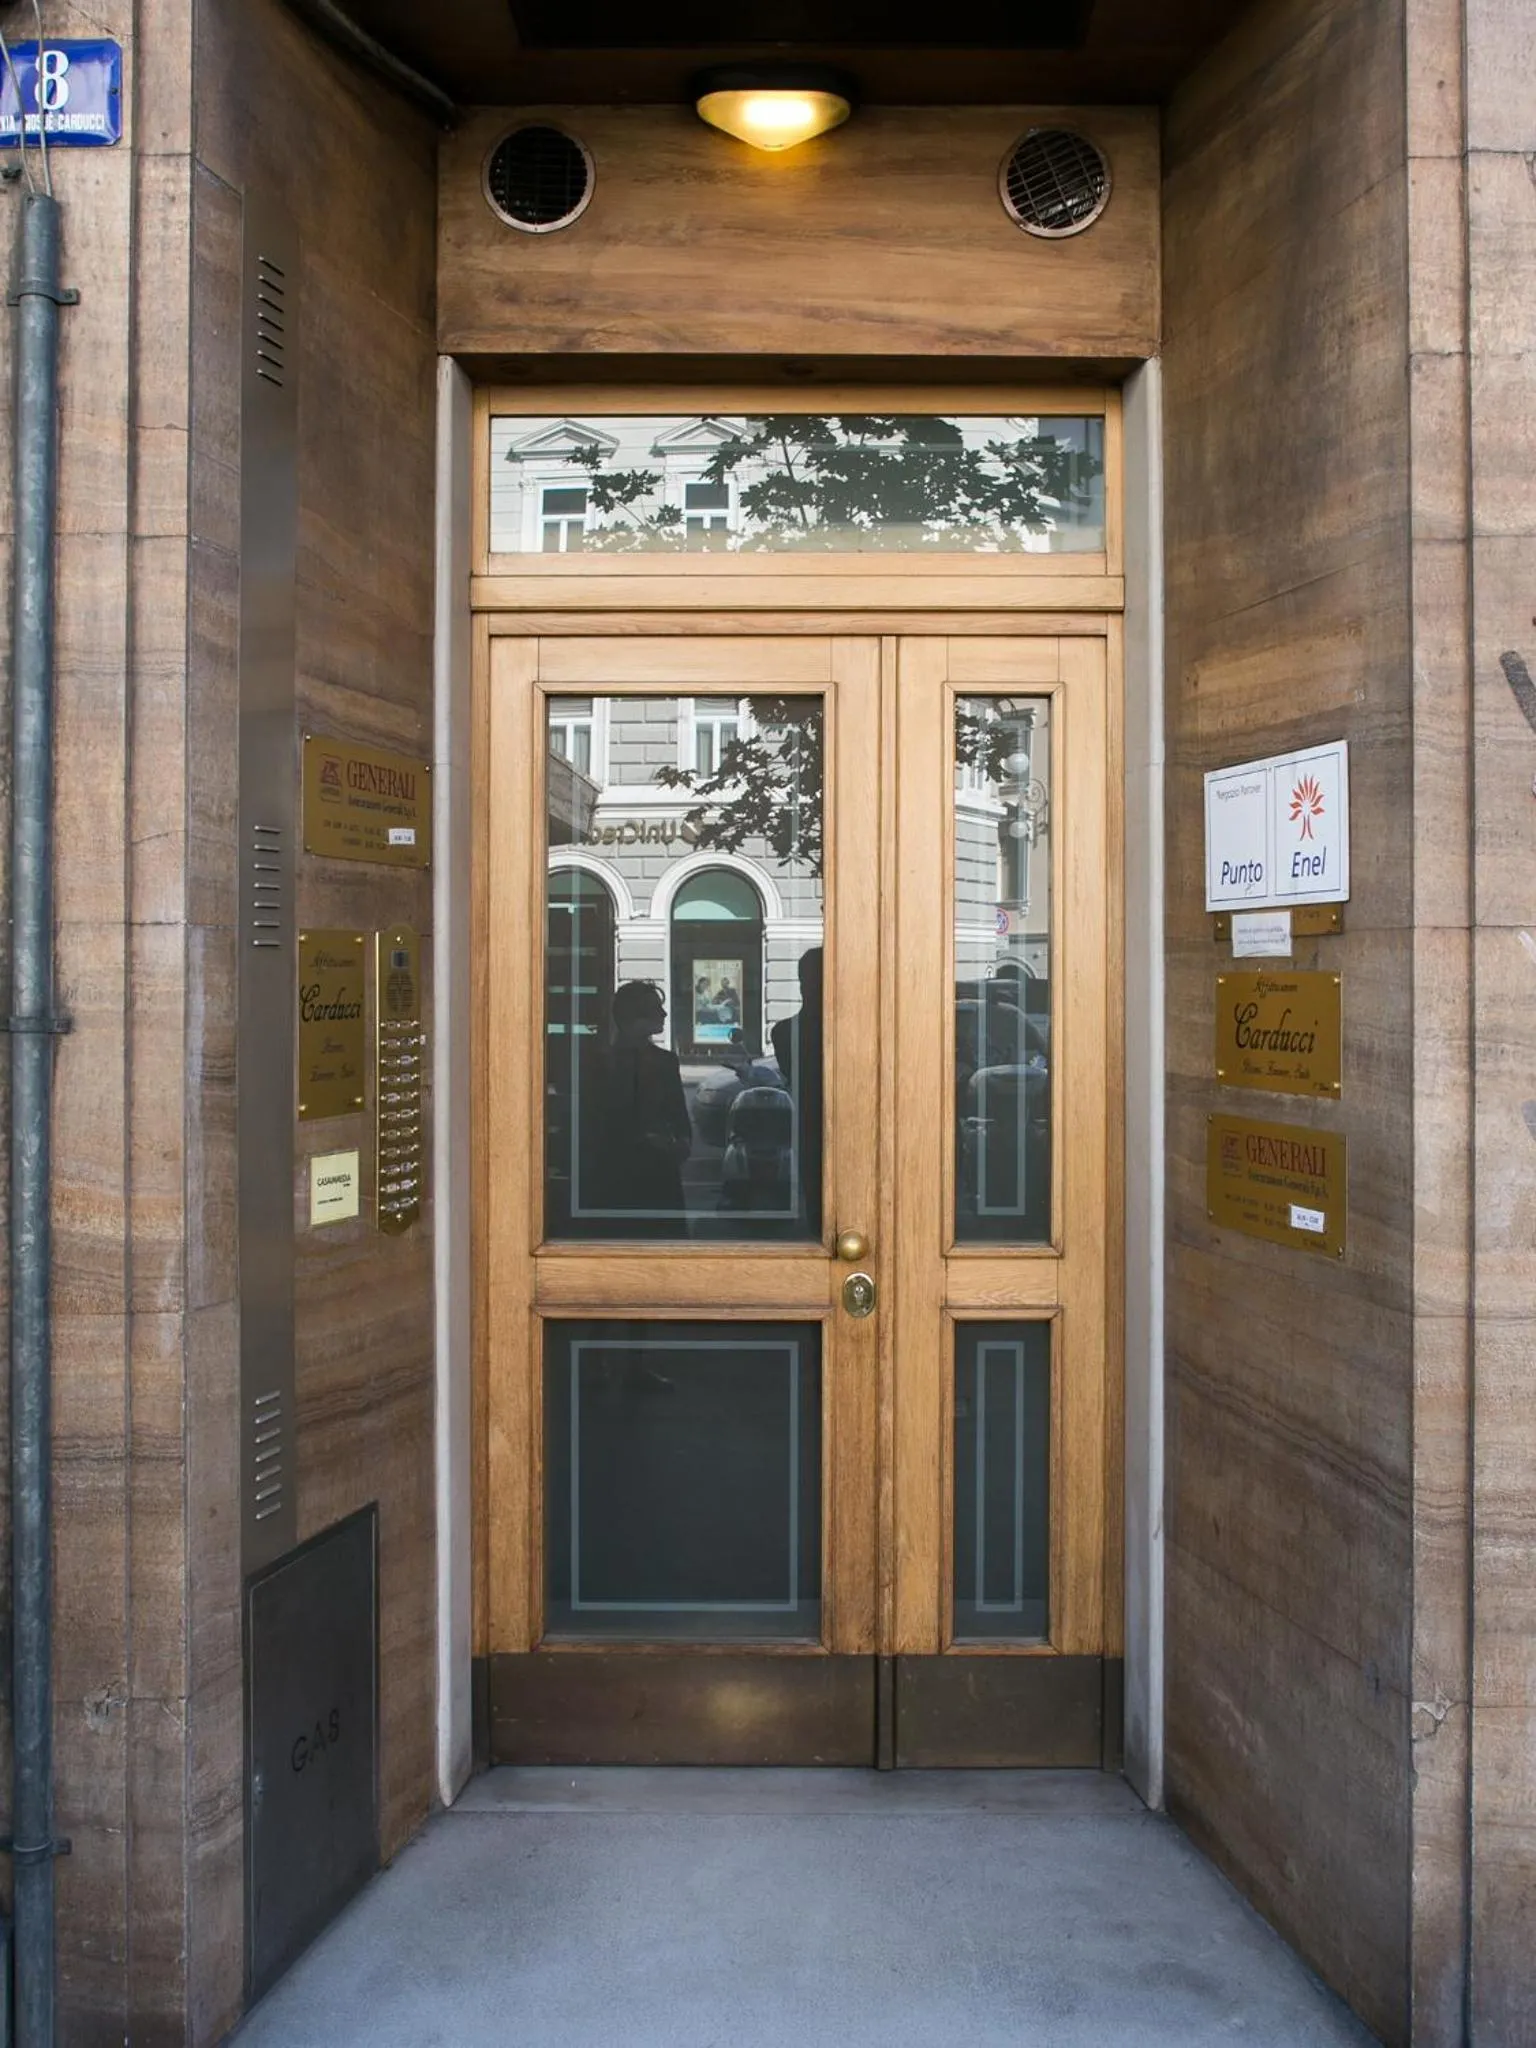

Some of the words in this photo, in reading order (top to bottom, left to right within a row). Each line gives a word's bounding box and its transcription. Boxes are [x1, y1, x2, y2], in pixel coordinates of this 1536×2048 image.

[34, 50, 69, 110] 8
[58, 113, 105, 131] CARDUCCI
[346, 760, 416, 801] GENERALI
[1221, 861, 1263, 885] Punto
[1291, 846, 1327, 878] Enel
[299, 984, 364, 1022] Carducci
[1234, 1002, 1319, 1054] Carducci
[1246, 1134, 1327, 1178] GENERALI
[291, 1708, 341, 1772] GAS
